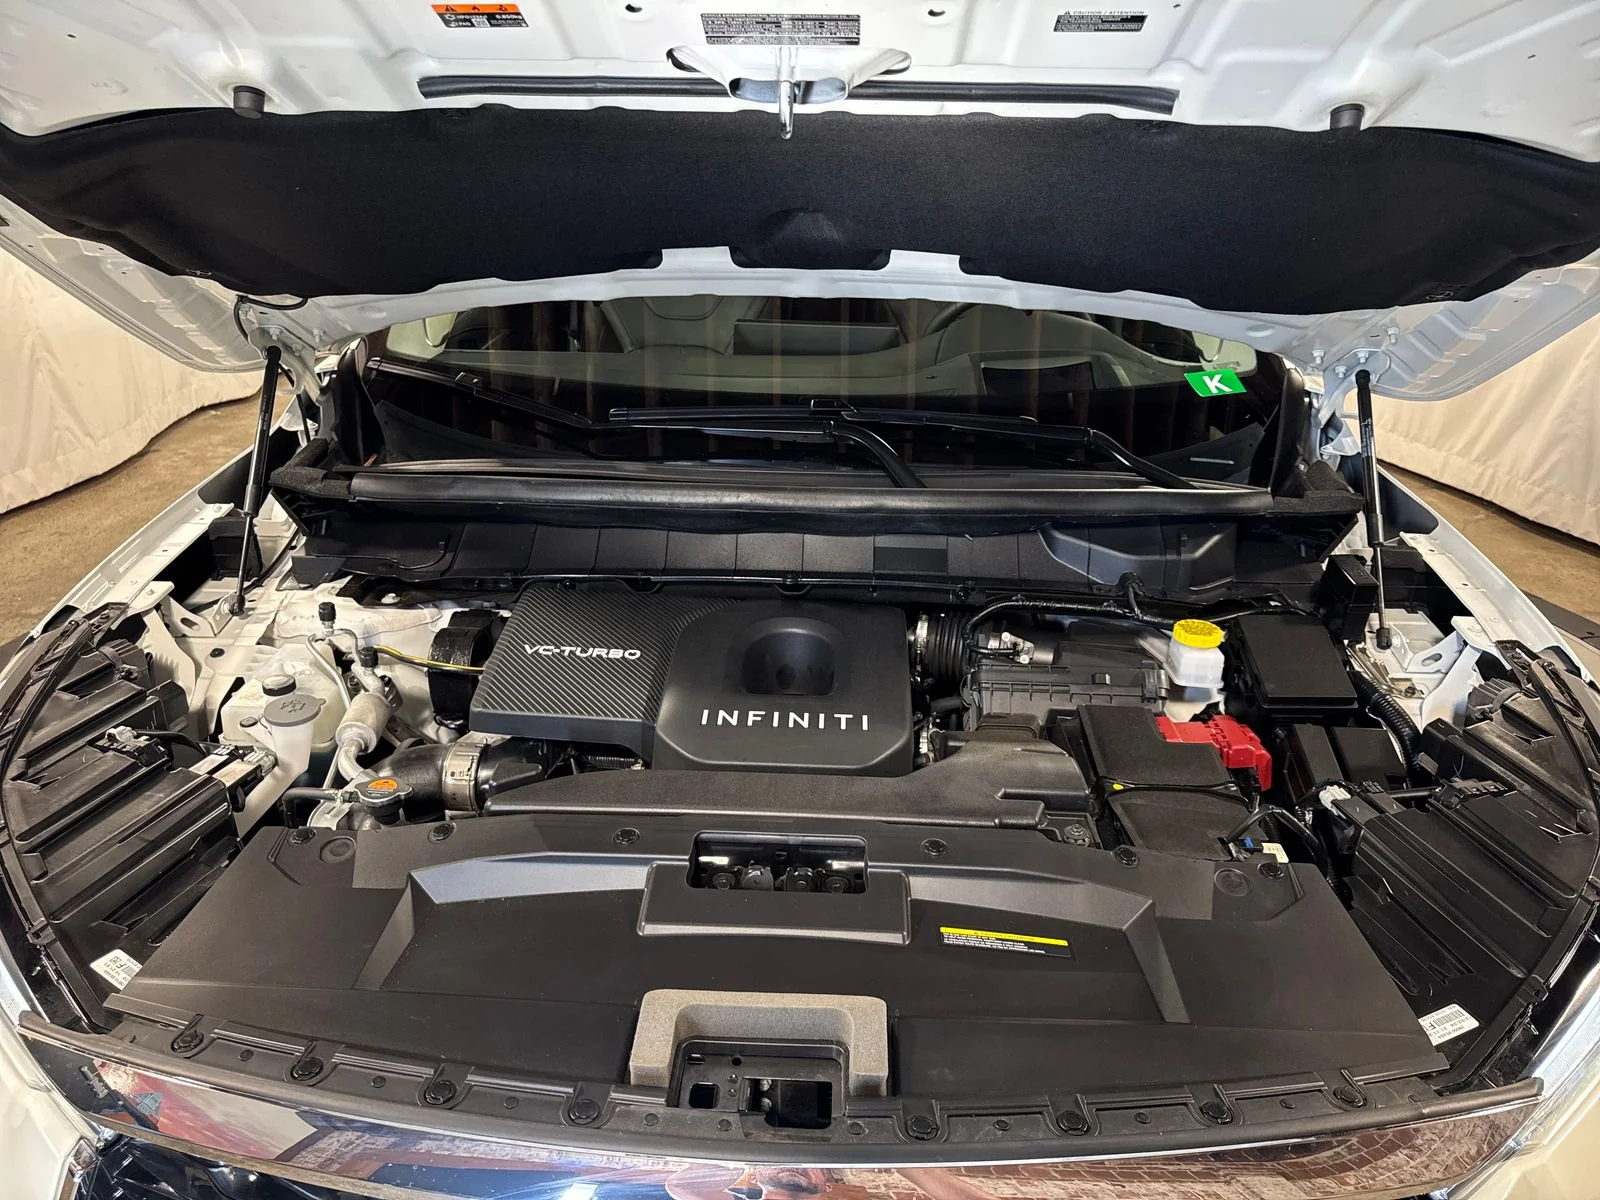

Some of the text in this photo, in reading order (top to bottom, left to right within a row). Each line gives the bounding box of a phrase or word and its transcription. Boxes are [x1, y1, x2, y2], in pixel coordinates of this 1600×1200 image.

[1202, 373, 1233, 394] K
[524, 644, 642, 660] VC-TURBO
[701, 709, 869, 731] INFINITI
